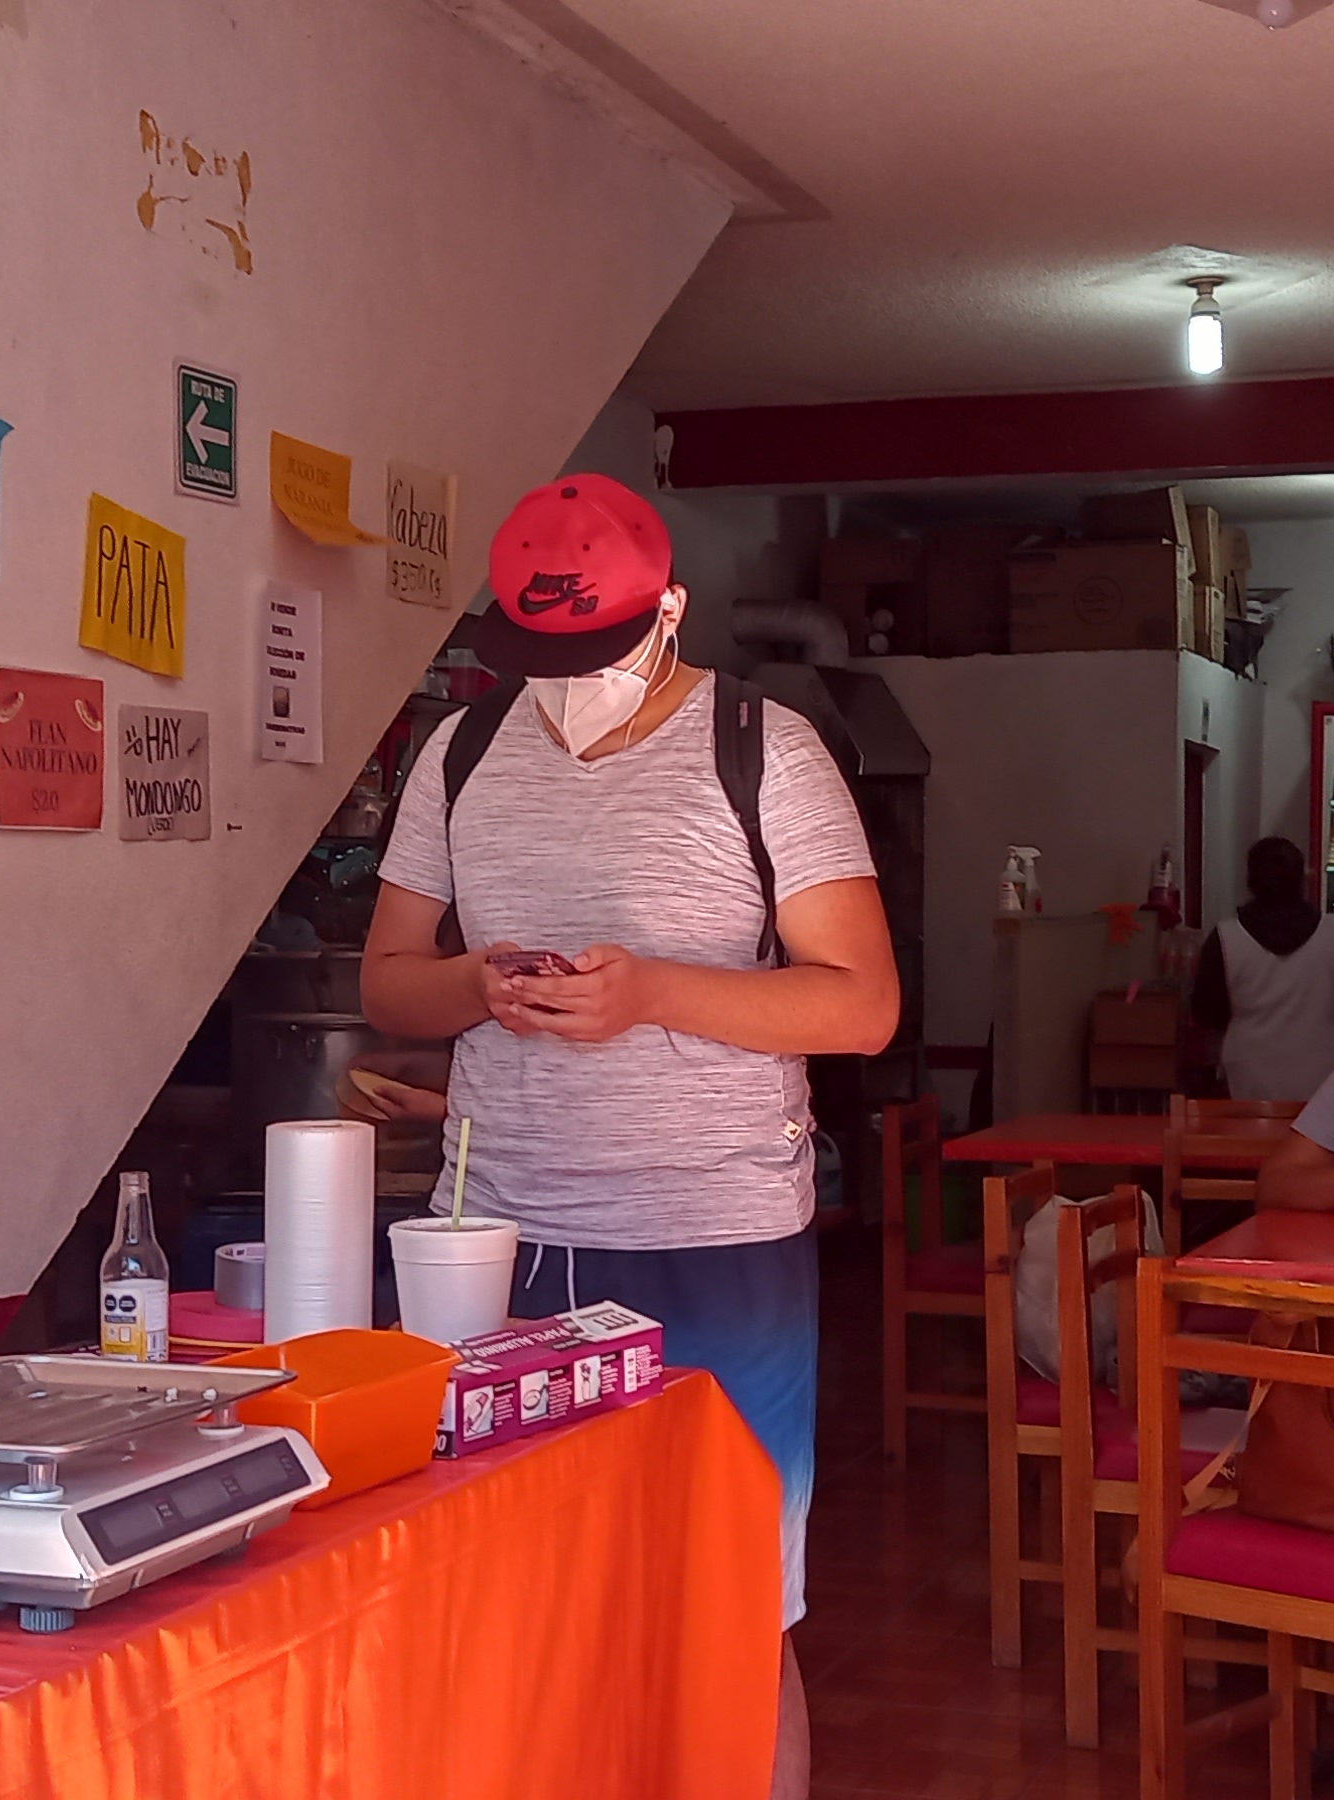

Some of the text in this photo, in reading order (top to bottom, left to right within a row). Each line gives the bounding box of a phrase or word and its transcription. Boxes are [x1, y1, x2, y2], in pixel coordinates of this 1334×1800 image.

[213, 385, 225, 403] DE
[97, 525, 174, 649] PATA
[28, 718, 67, 745] FLAN
[144, 715, 181, 764] HAY
[1, 744, 98, 776] NAPOLITANO
[31, 787, 59, 814] $20
[125, 777, 202, 818] MONDONGO
